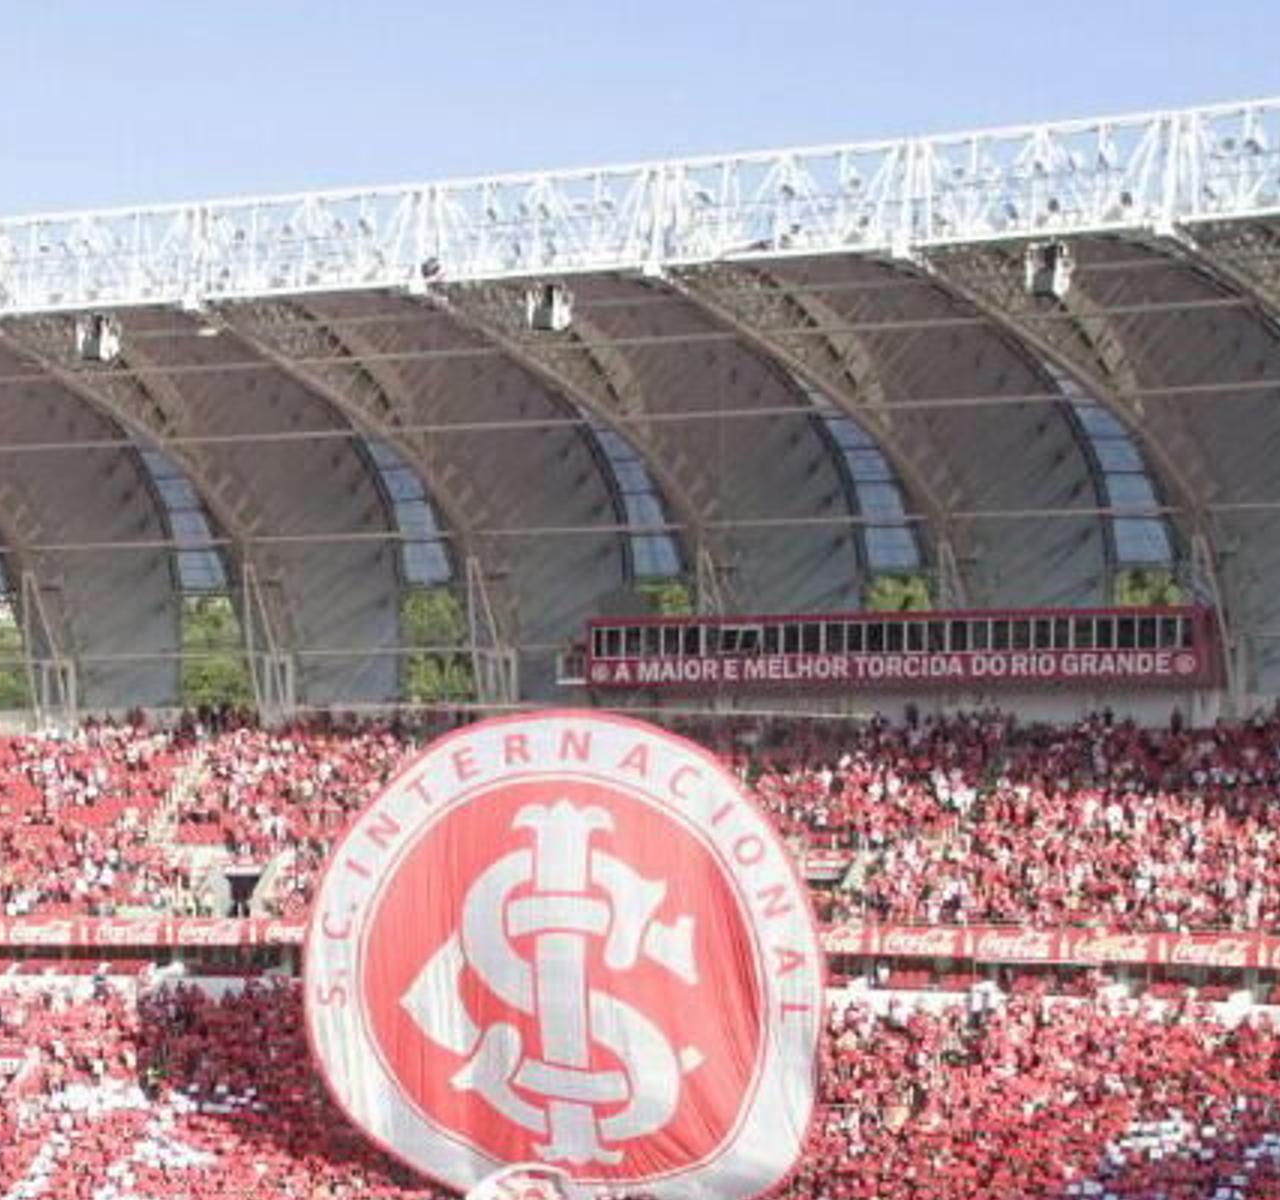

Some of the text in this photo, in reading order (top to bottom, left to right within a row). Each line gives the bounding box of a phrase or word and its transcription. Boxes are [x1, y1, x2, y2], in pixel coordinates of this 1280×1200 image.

[614, 652, 1171, 682] A MAIOR E MELHOR TORCIDA DO RIO GRANDE
[345, 730, 810, 1025] INTERNACIONAL
